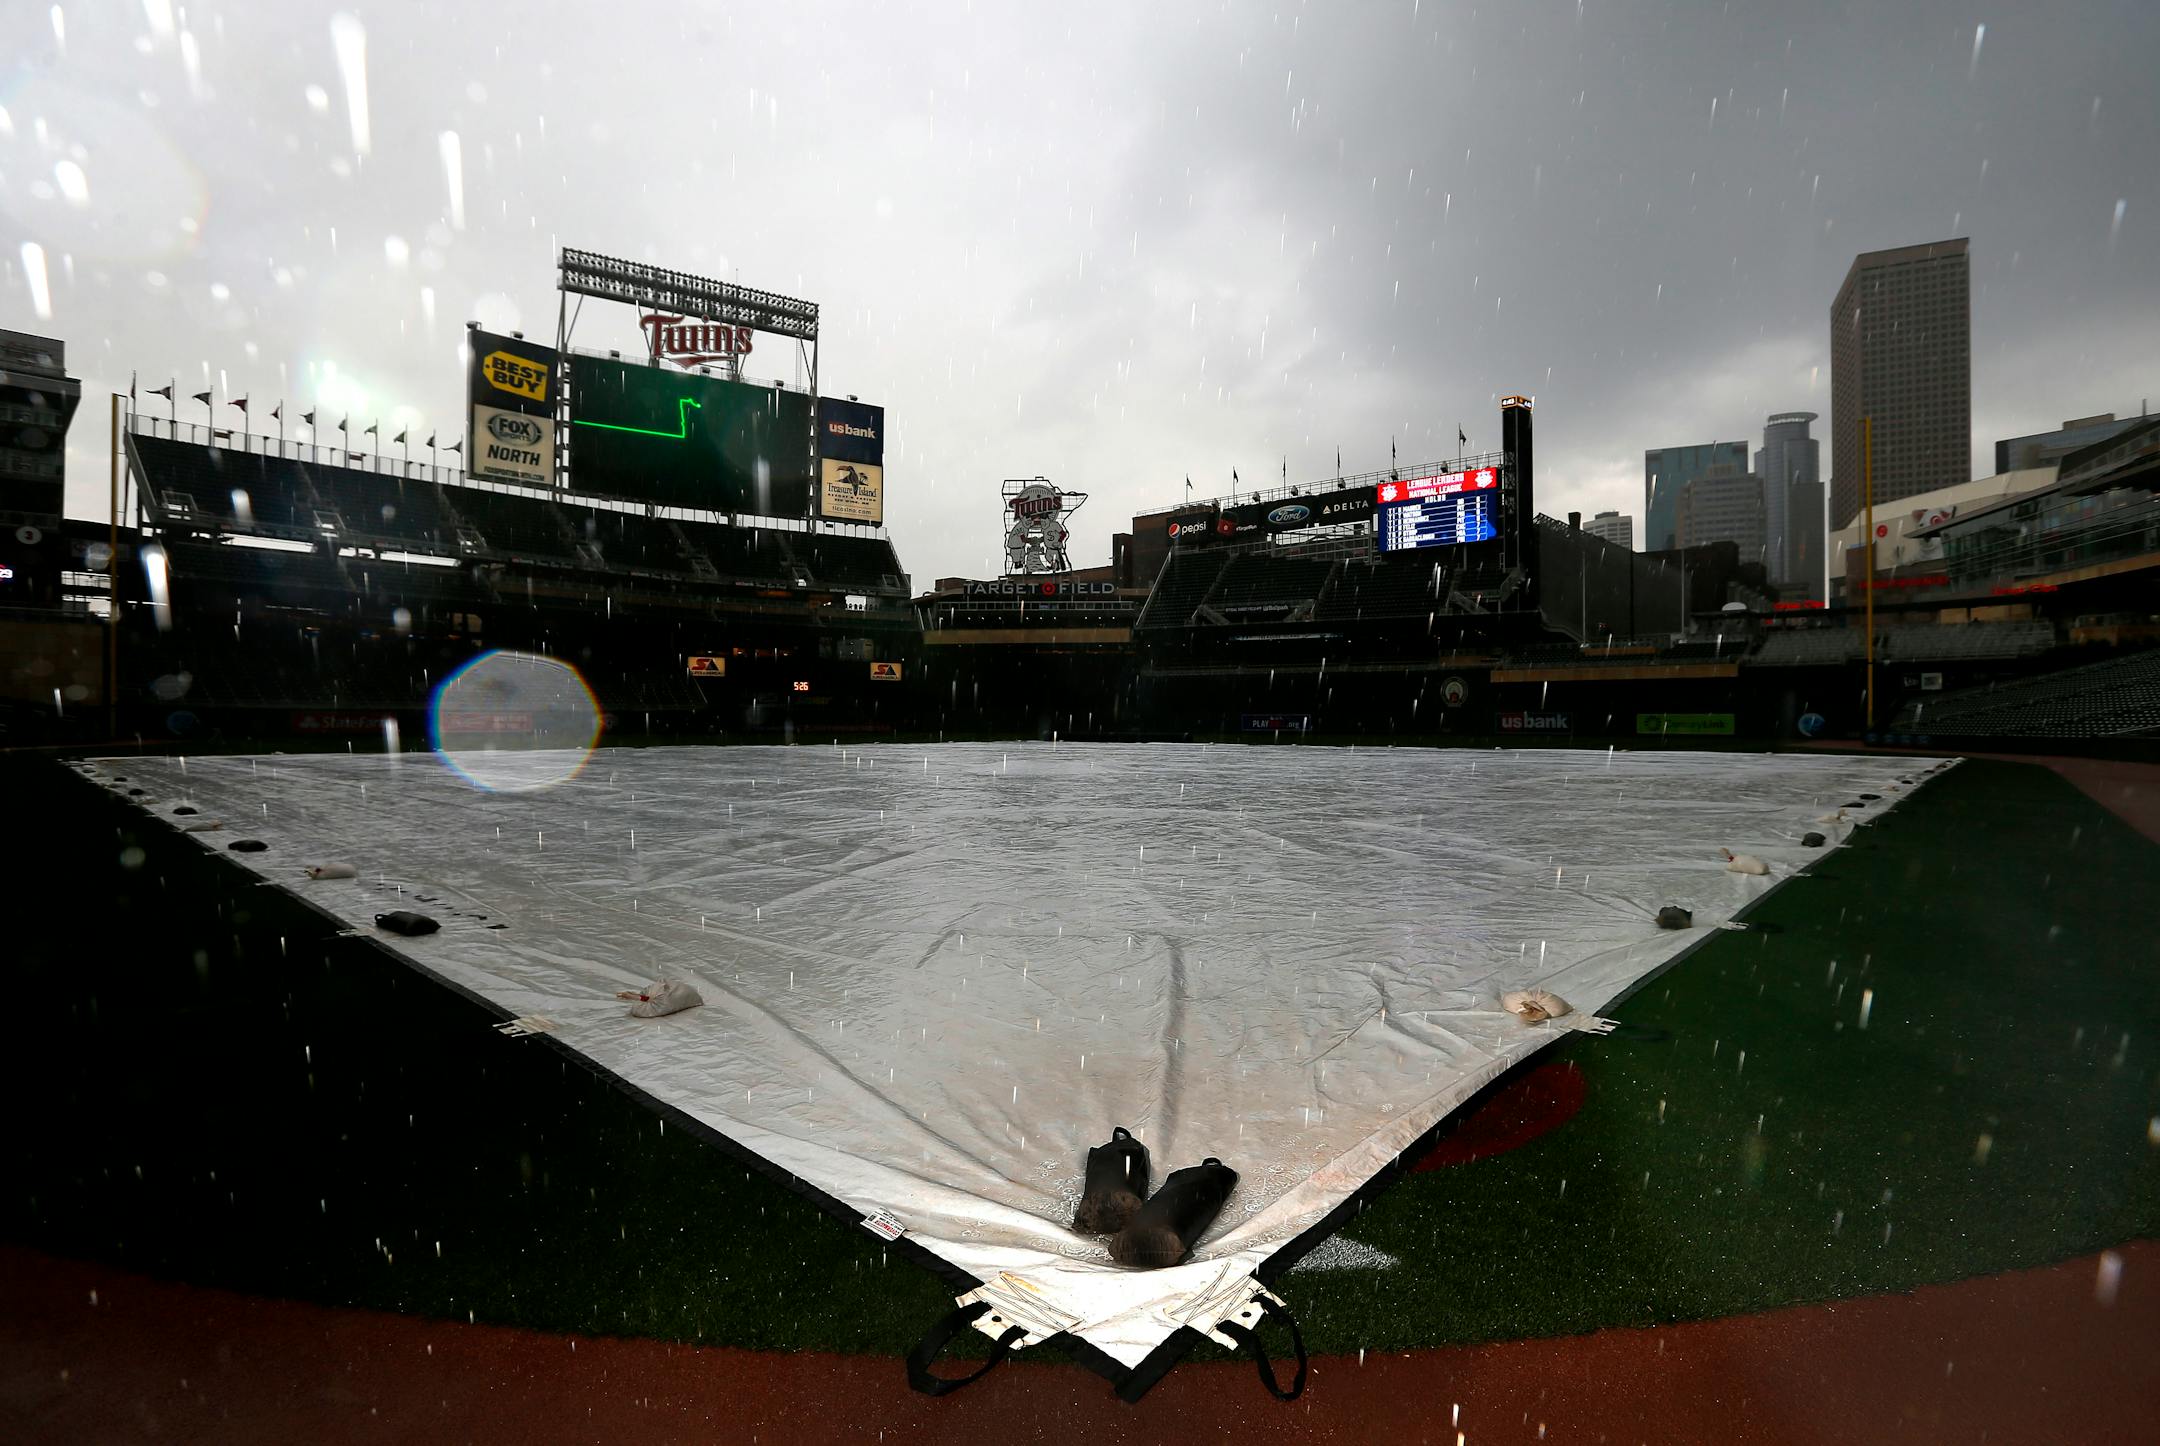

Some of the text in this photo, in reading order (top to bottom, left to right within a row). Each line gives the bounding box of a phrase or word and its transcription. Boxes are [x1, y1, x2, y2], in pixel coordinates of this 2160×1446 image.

[640, 313, 753, 358] Twins
[492, 356, 546, 383] BEST
[493, 370, 540, 393] BUY
[499, 417, 530, 435] FOX
[829, 423, 876, 439] usbank
[488, 444, 541, 466] NORTH
[827, 482, 853, 495] Treasure
[858, 487, 877, 498] Island
[1409, 484, 1462, 499] NATIONAL LEAGUE
[1009, 495, 1063, 522] Twins
[1333, 499, 1369, 512] DELTA
[1276, 509, 1301, 522] Ford
[1182, 520, 1207, 535] pepsi
[963, 583, 1115, 594] TARGET FIELD
[1502, 711, 1569, 729] usbank
